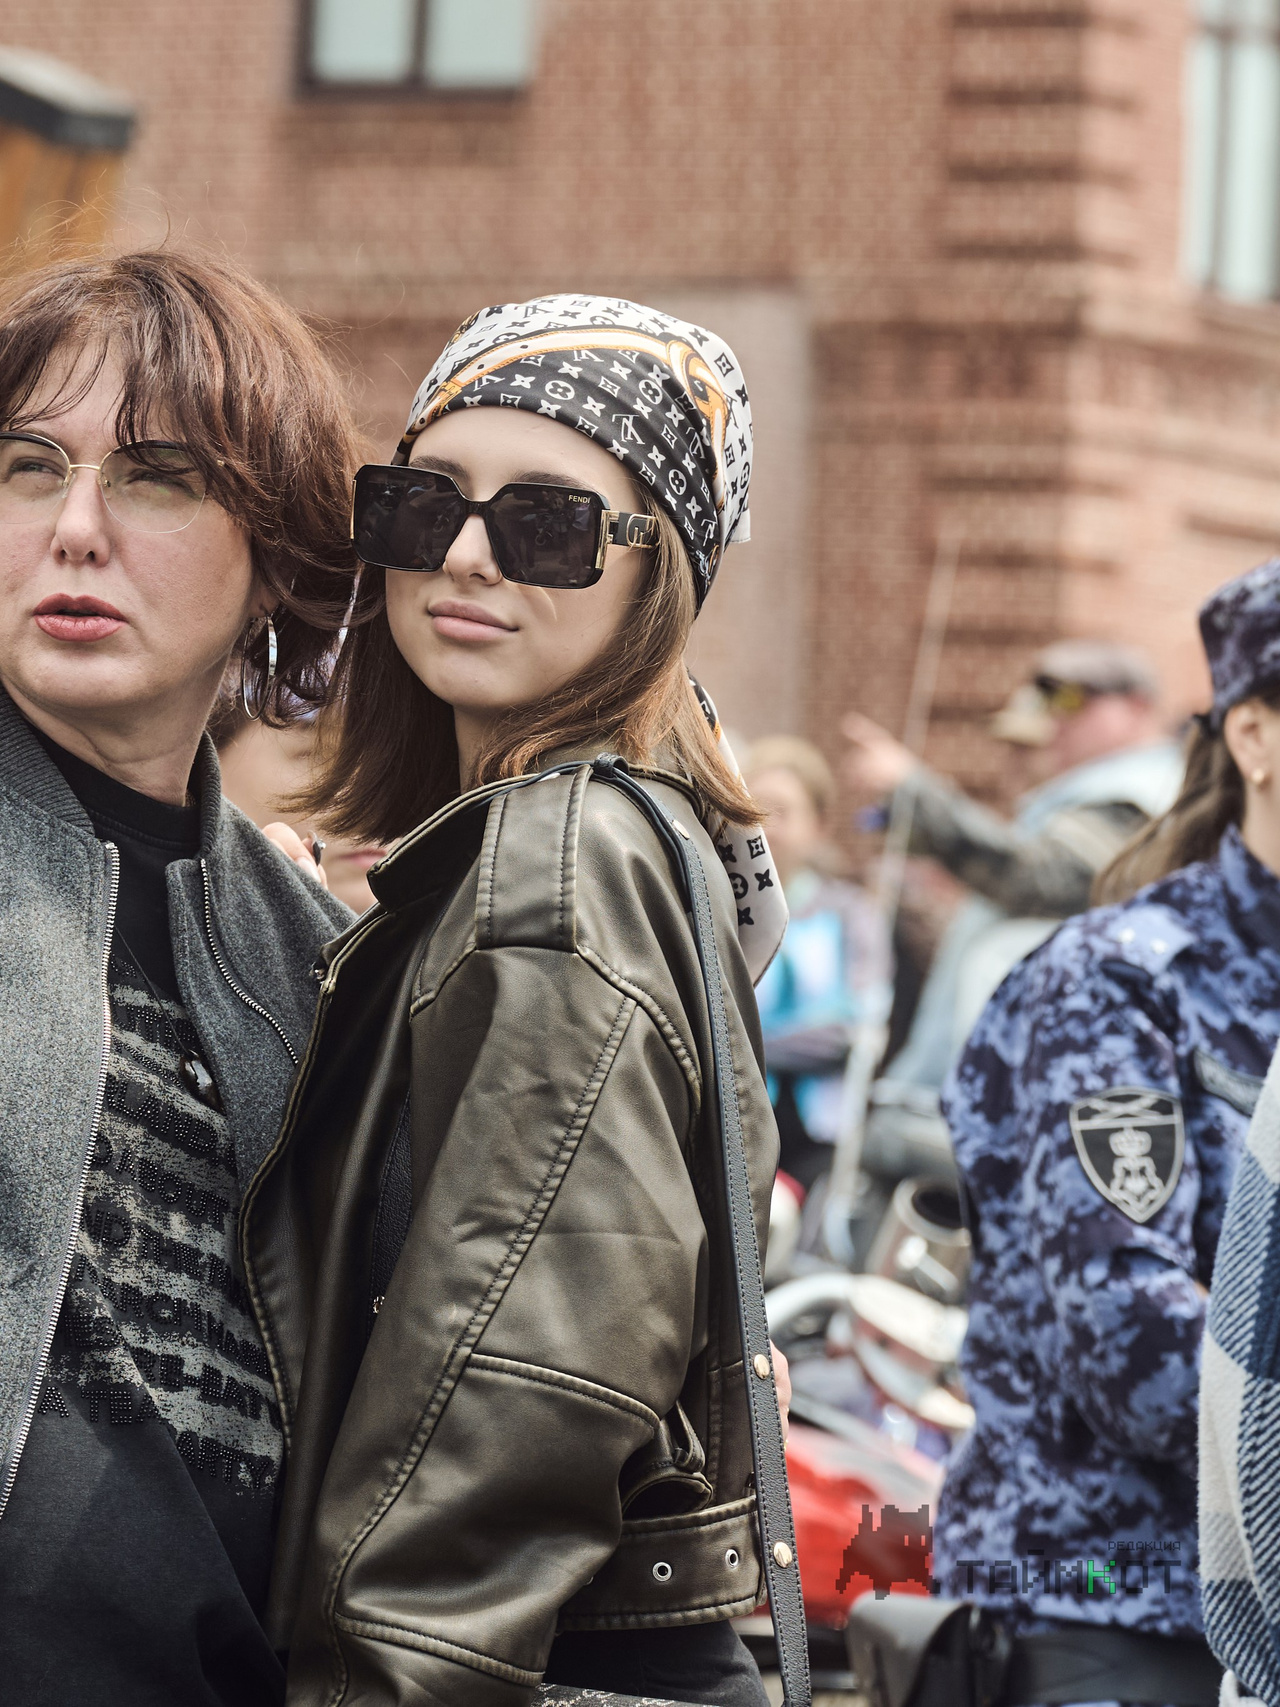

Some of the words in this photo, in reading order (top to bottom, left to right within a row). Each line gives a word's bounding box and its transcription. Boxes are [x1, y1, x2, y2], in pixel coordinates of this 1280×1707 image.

[568, 494, 591, 504] FENDI
[115, 1148, 229, 1225] ABOUT
[37, 1385, 70, 1418] A
[176, 1431, 269, 1489] ARTY
